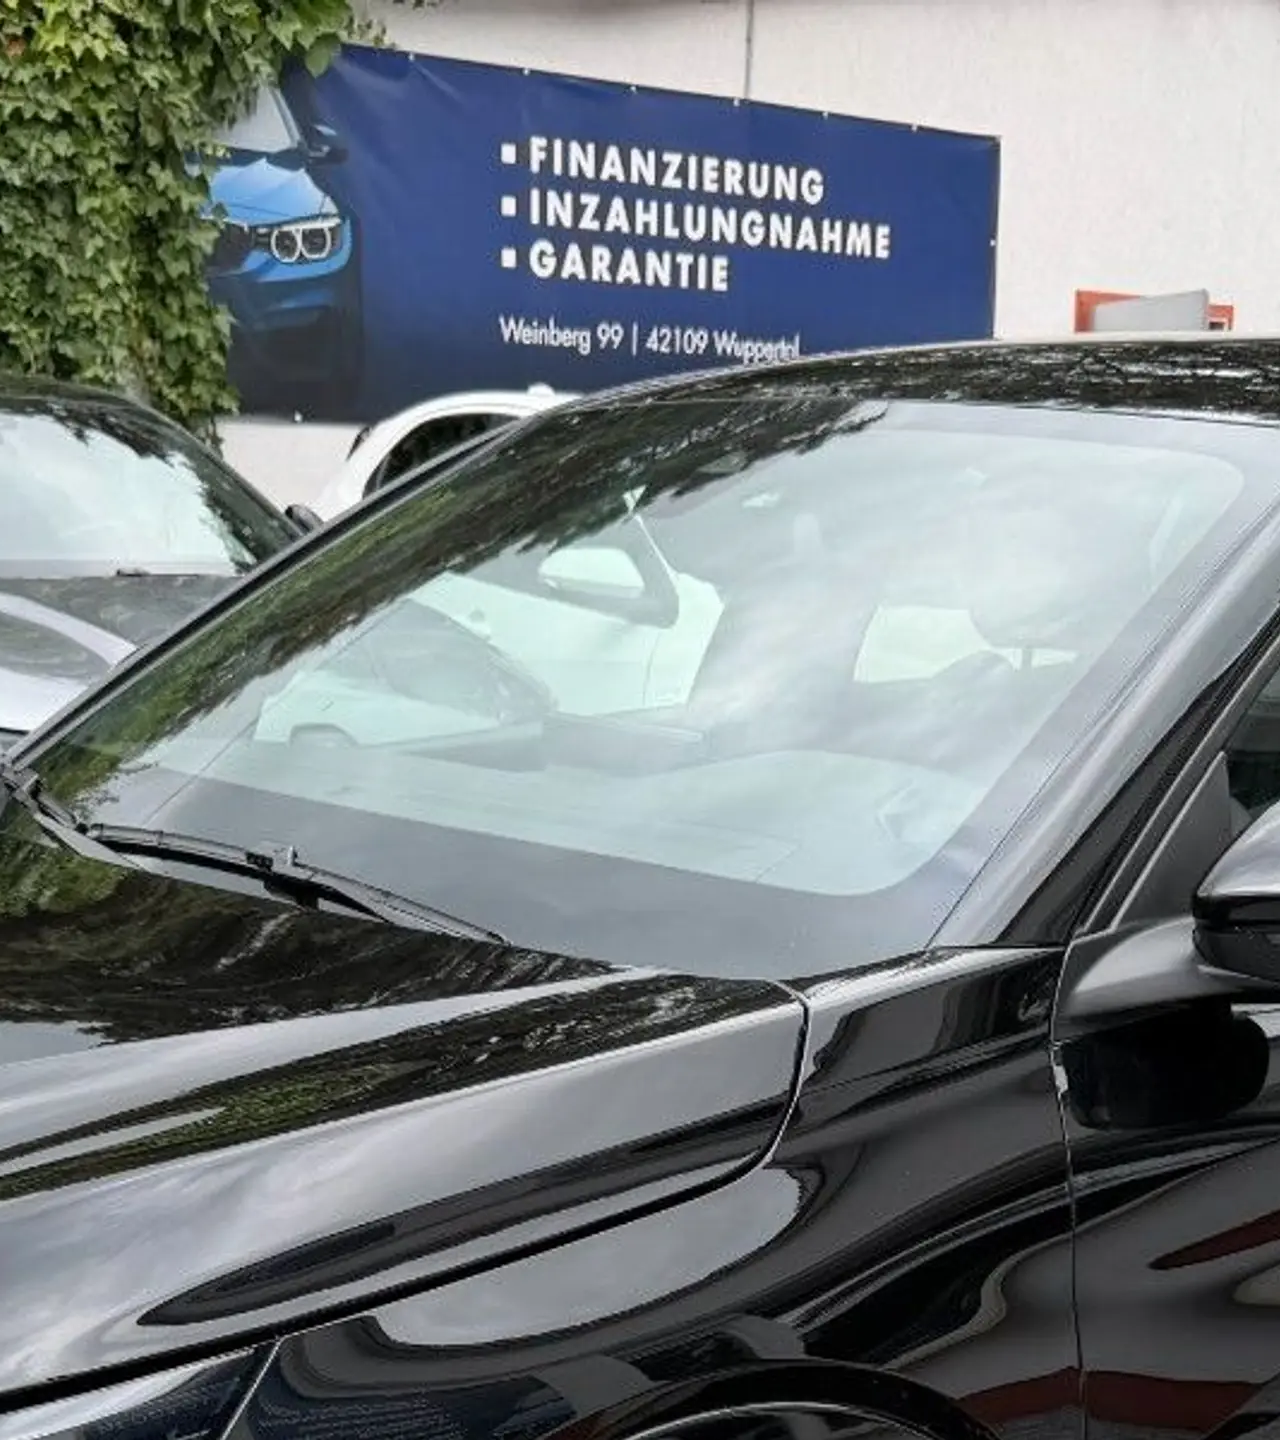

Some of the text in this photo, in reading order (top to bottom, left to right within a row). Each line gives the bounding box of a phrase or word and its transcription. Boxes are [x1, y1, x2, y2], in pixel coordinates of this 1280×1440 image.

[529, 135, 825, 206] FINANZIERUNG
[529, 187, 892, 260] INZAHLUNGNAHME
[528, 237, 730, 292] GARANTIE
[499, 314, 591, 356] Weinberg
[596, 320, 624, 350] 99
[645, 325, 709, 356] 42109
